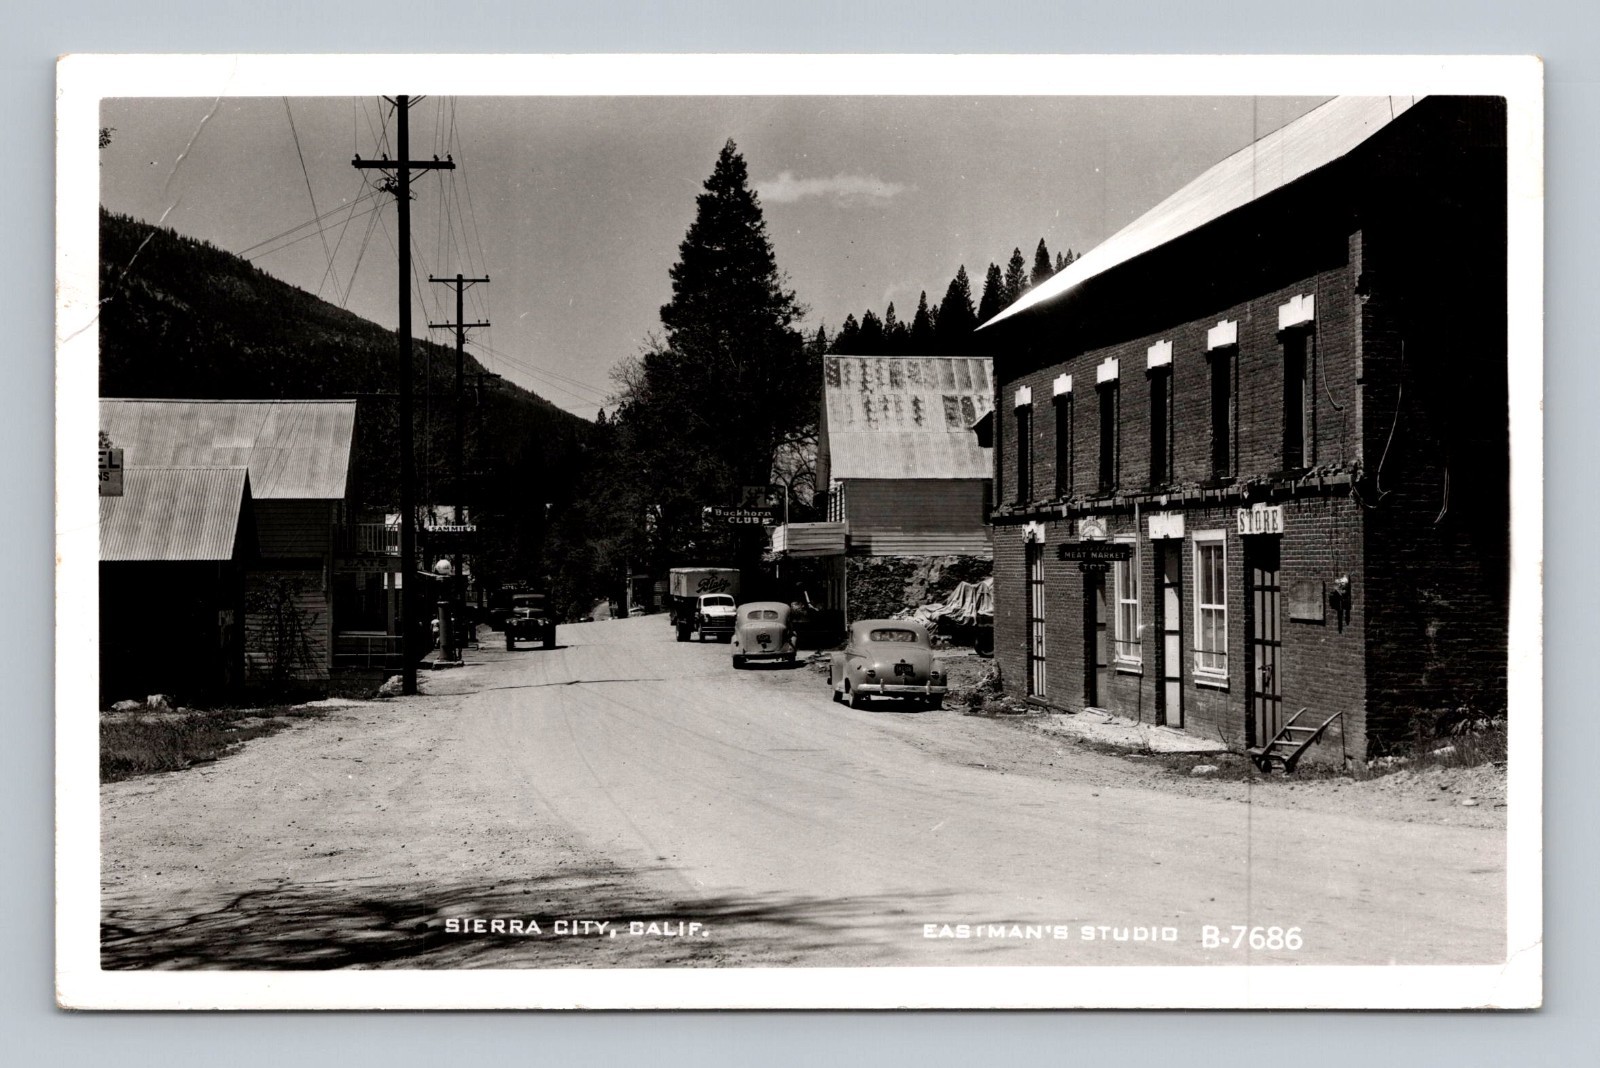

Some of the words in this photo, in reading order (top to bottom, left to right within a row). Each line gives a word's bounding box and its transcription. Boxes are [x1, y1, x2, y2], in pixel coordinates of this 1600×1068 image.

[714, 508, 772, 517] Buckhorn
[1240, 510, 1279, 532] STORE
[1064, 551, 1087, 559] MEAT
[344, 559, 388, 567] EATS
